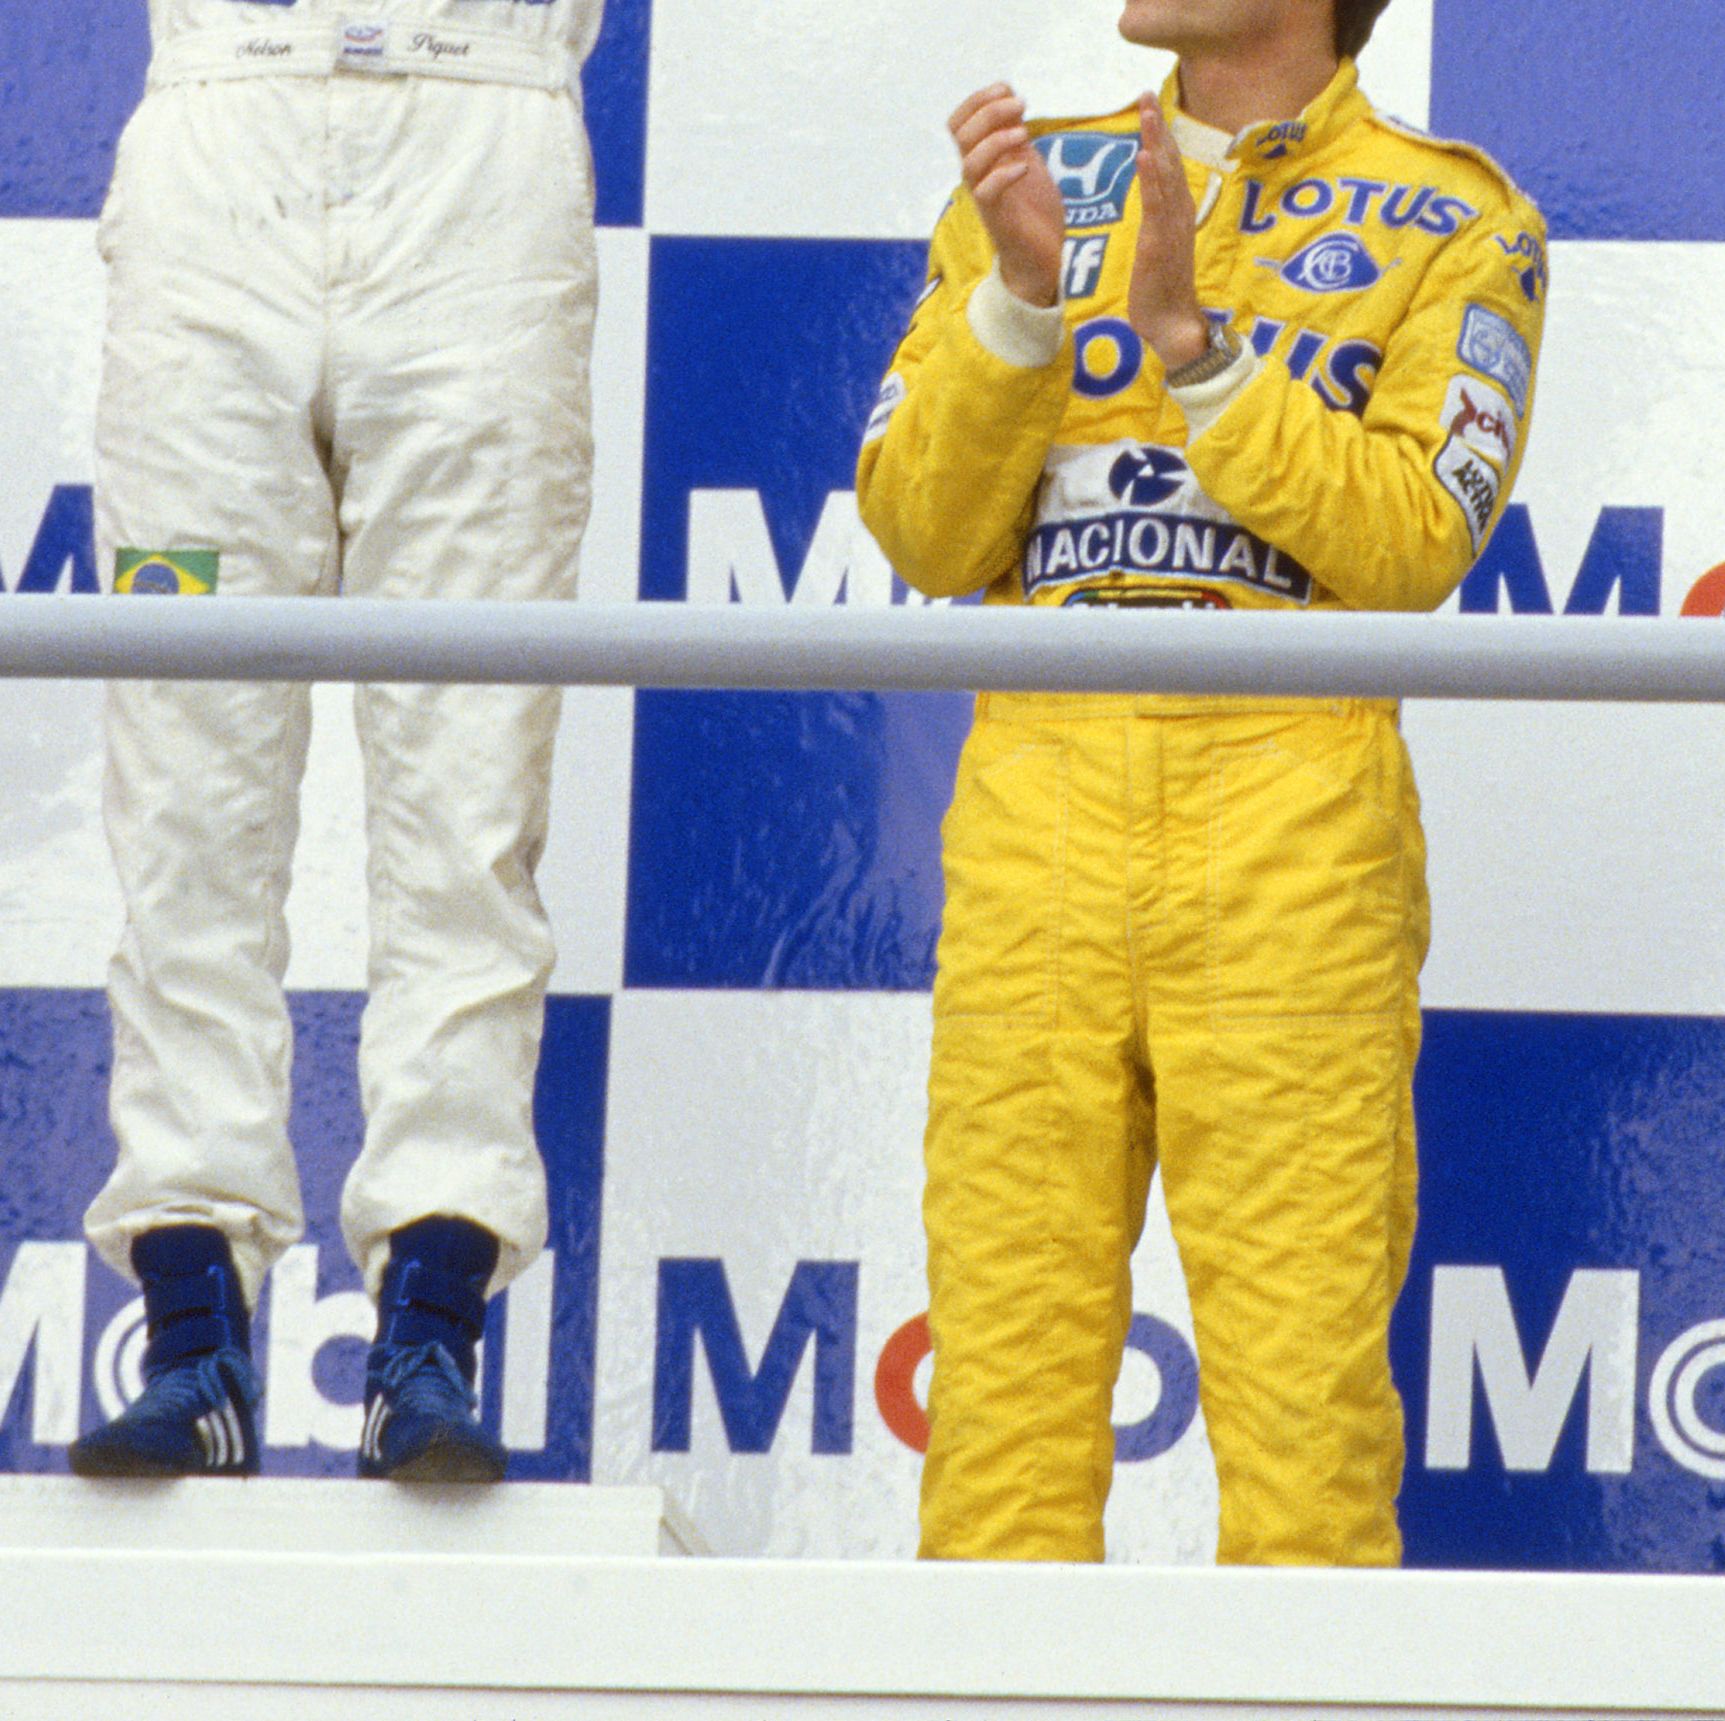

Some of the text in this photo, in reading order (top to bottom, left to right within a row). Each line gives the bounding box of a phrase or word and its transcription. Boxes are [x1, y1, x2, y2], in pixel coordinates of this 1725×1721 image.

[1238, 175, 1484, 237] LOTUS
[1060, 237, 1107, 295] lf
[1027, 517, 1293, 590] NACIONAL
